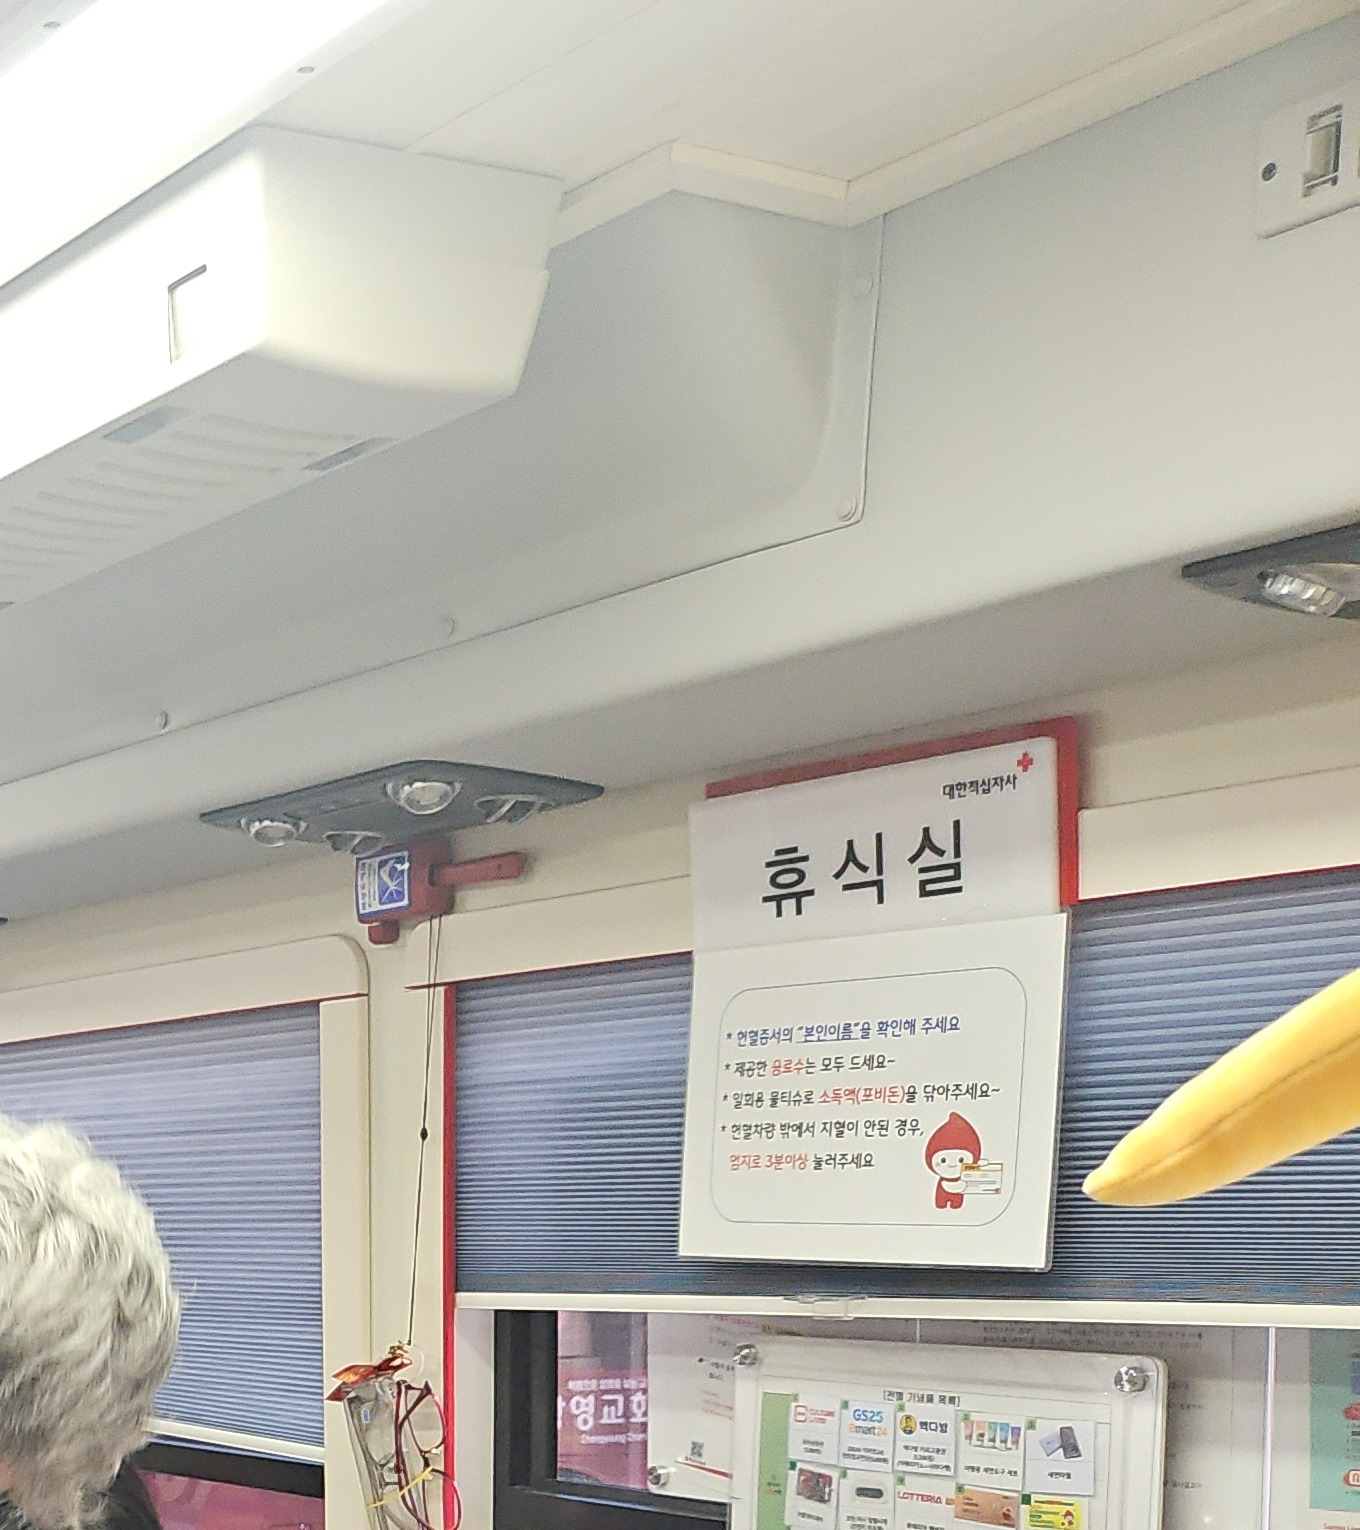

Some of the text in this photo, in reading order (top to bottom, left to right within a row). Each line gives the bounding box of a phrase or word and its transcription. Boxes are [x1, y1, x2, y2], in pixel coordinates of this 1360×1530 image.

[943, 774, 1018, 799] 대한적십자사
[737, 1025, 793, 1047] 헌혈증서의
[876, 1018, 916, 1038] 확인해
[920, 1016, 961, 1033] 주세요
[733, 1060, 768, 1077] 제공한
[771, 1058, 817, 1077] 음료수는
[820, 1056, 845, 1073] 모두
[733, 1091, 765, 1109] 일회용
[769, 1089, 815, 1108] 물티슈로
[731, 1118, 925, 1140] 헌혈차량 밖에서 지혈이 안된 경우,
[730, 1152, 875, 1171] 엄지로 3분이상 눌러주세요
[853, 1408, 883, 1424] GS25
